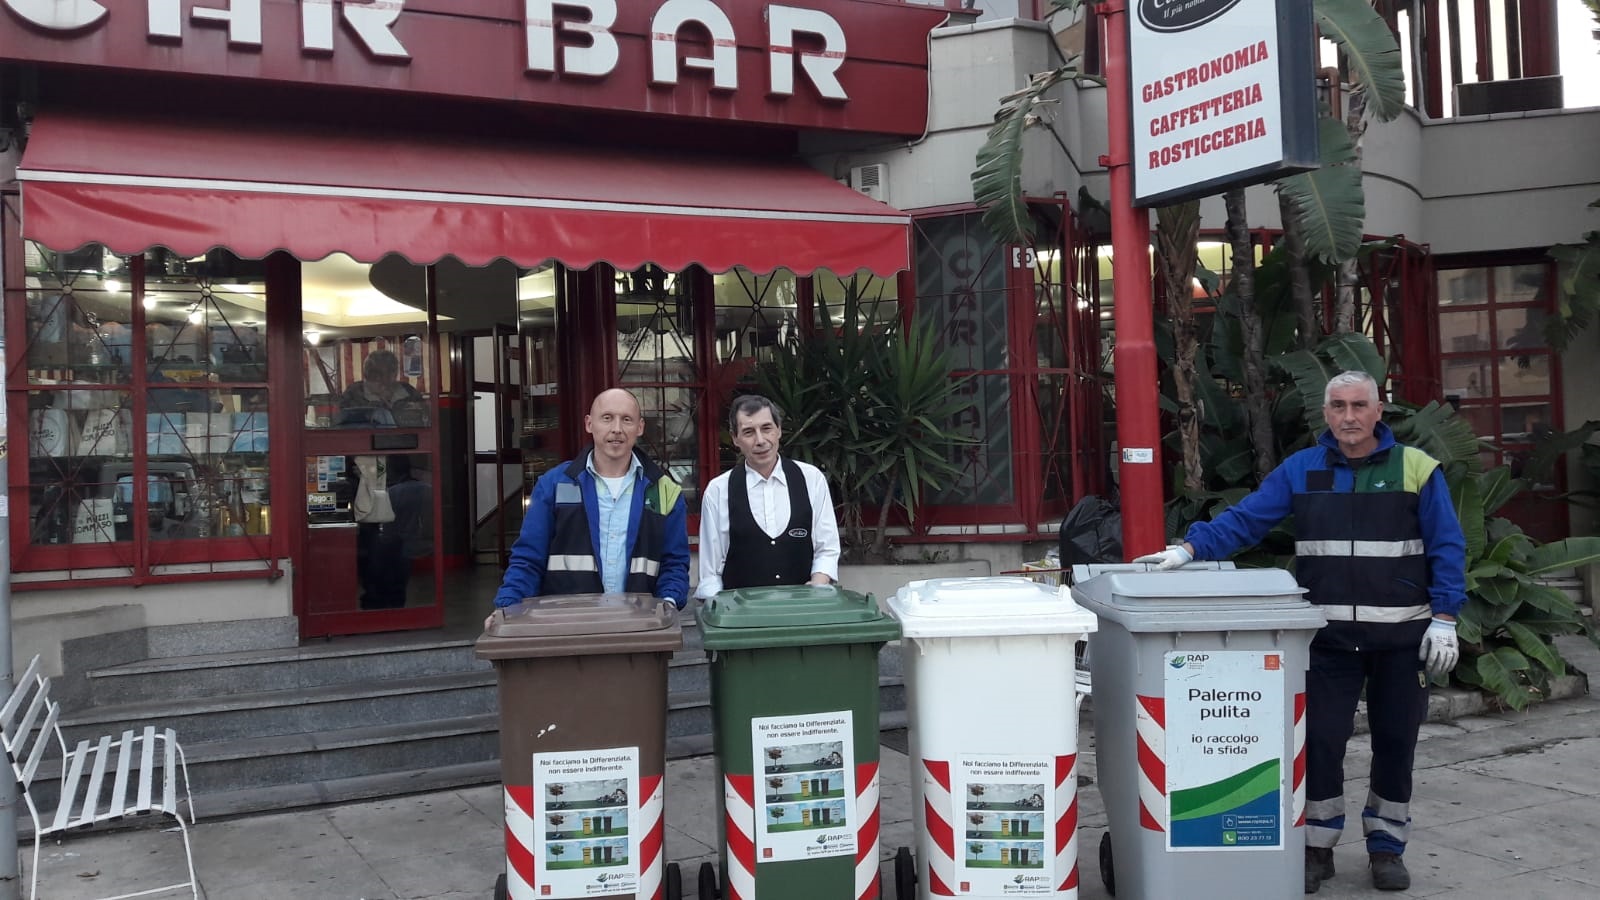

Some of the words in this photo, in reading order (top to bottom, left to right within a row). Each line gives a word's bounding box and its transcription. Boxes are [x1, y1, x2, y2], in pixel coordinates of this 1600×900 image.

[525, 0, 848, 99] BAR
[1142, 40, 1268, 103] GASTRONOMIA
[1150, 83, 1263, 137] CAFFETTERIA
[1149, 117, 1266, 169] ROSTICCERIA
[1187, 654, 1210, 662] RAP
[1188, 688, 1262, 702] Palermo
[1200, 705, 1250, 721] pulita
[780, 730, 801, 738] essere
[1191, 733, 1203, 743] io
[1207, 733, 1259, 745] raccolgo
[1203, 745, 1213, 755] la
[1217, 745, 1248, 755] sfida
[552, 758, 581, 766] facciamo
[974, 760, 1002, 768] facciamo
[548, 767, 561, 775] non
[562, 766, 584, 774] essere
[608, 872, 625, 880] RAP
